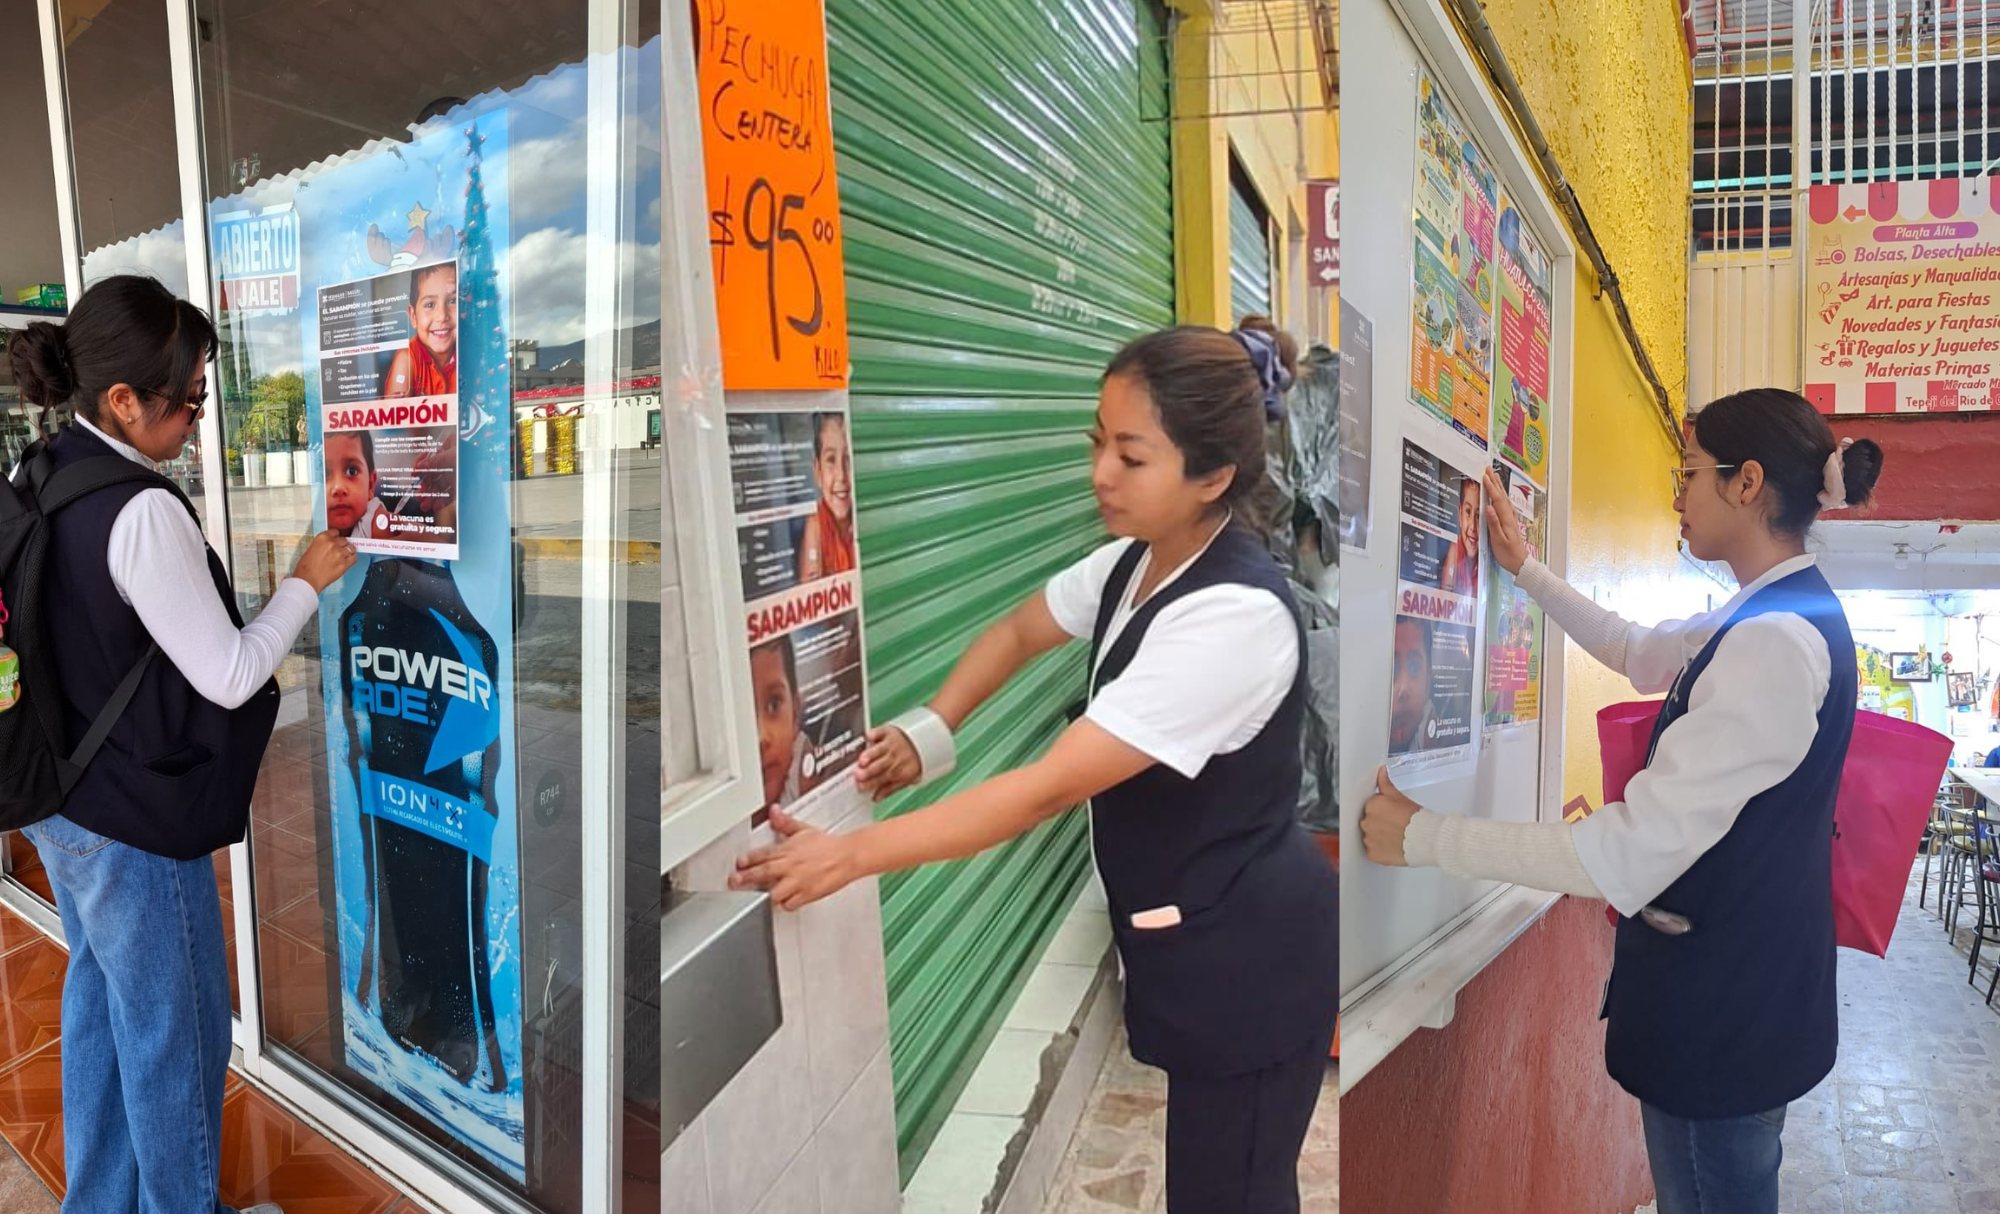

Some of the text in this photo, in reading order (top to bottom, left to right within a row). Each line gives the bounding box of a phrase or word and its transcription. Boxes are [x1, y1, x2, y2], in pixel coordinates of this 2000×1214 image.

[1894, 226, 1930, 240] Planta
[220, 215, 293, 274] ABIERTO
[1853, 246, 1908, 263] Bolsas,
[1837, 266, 2000, 289] Artesanías y Manualida
[237, 280, 280, 307] JALE
[1866, 291, 1991, 313] Art. para Fiestas
[329, 302, 361, 314] SARAMPIÓN
[367, 298, 385, 308] puede
[1841, 314, 2000, 334] Novedades y Fantasí
[1856, 337, 1999, 358] Regalos y Juguetes
[1865, 359, 1991, 378] Materias Primas
[1942, 379, 1986, 390] Mercado
[1905, 395, 1938, 410] Tepeji
[1940, 395, 1958, 407] del
[1980, 394, 1993, 406] de
[328, 399, 448, 429] SARAMPIÓN
[389, 522, 455, 534] gratuita y segura.
[398, 515, 424, 523] vacuna
[747, 579, 852, 642] SARAMPIÓN
[350, 646, 491, 711] POWER
[540, 784, 560, 806] R744
